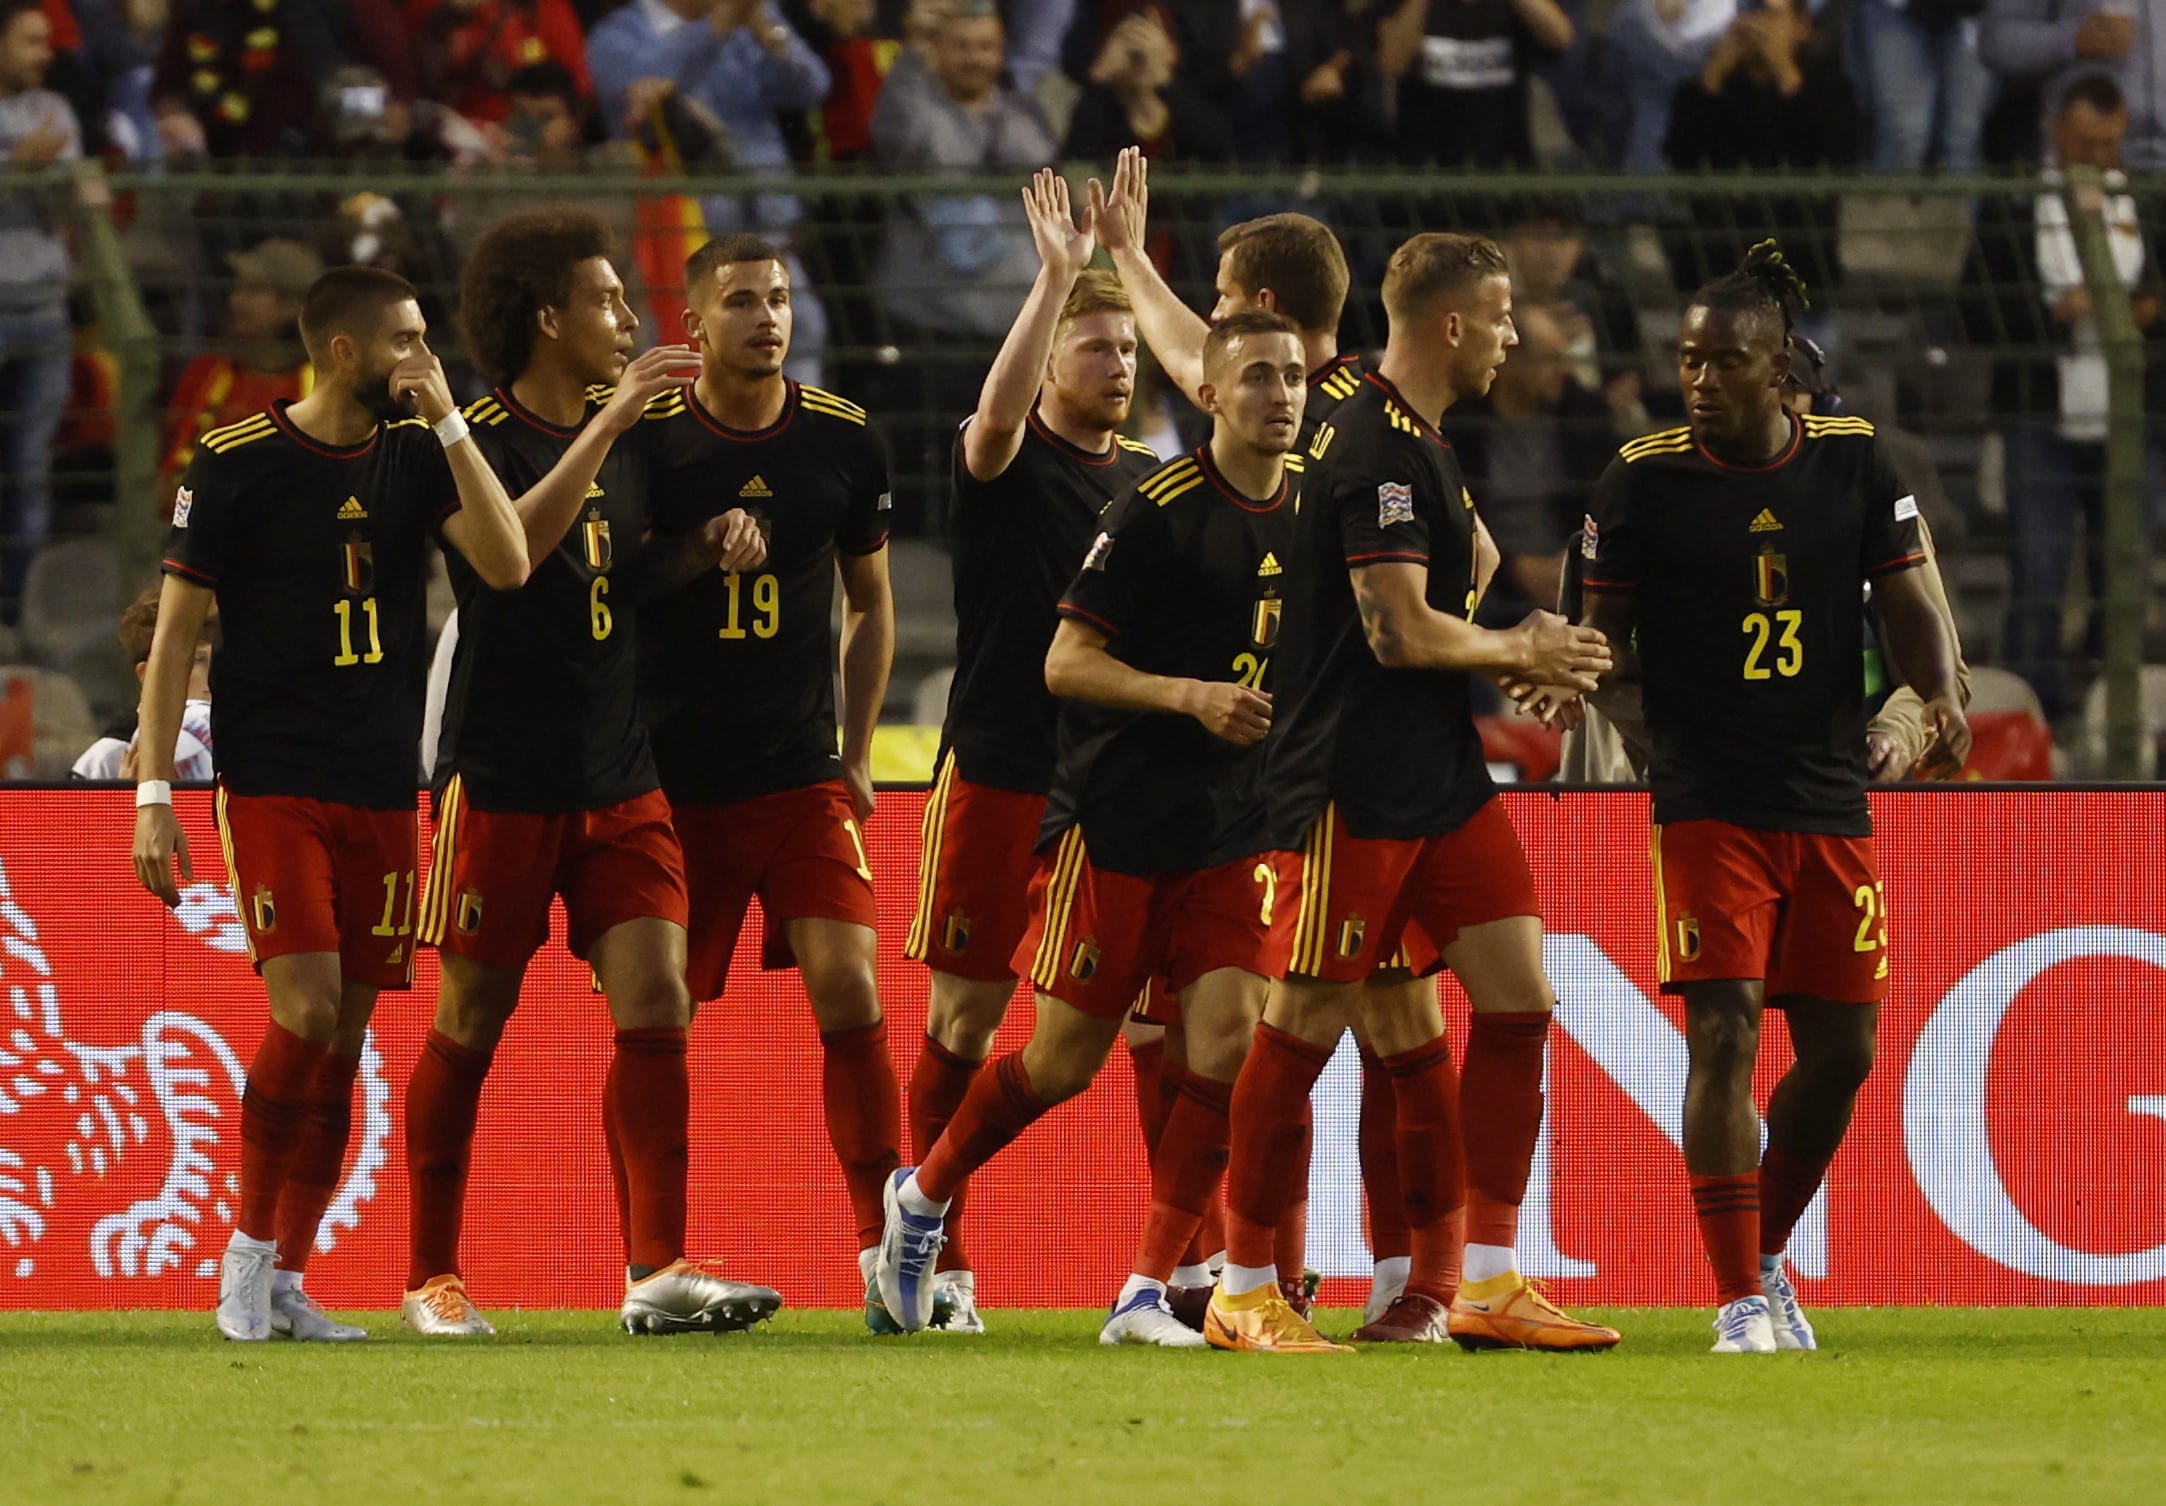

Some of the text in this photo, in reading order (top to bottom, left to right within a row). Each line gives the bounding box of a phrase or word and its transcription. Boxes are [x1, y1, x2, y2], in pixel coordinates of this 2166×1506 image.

[334, 597, 384, 666] 11
[590, 576, 612, 640] 6
[719, 573, 779, 639] 19
[1742, 609, 1803, 680] 23
[844, 818, 873, 881] 1
[372, 869, 414, 936] 11
[1254, 863, 1277, 926] 2
